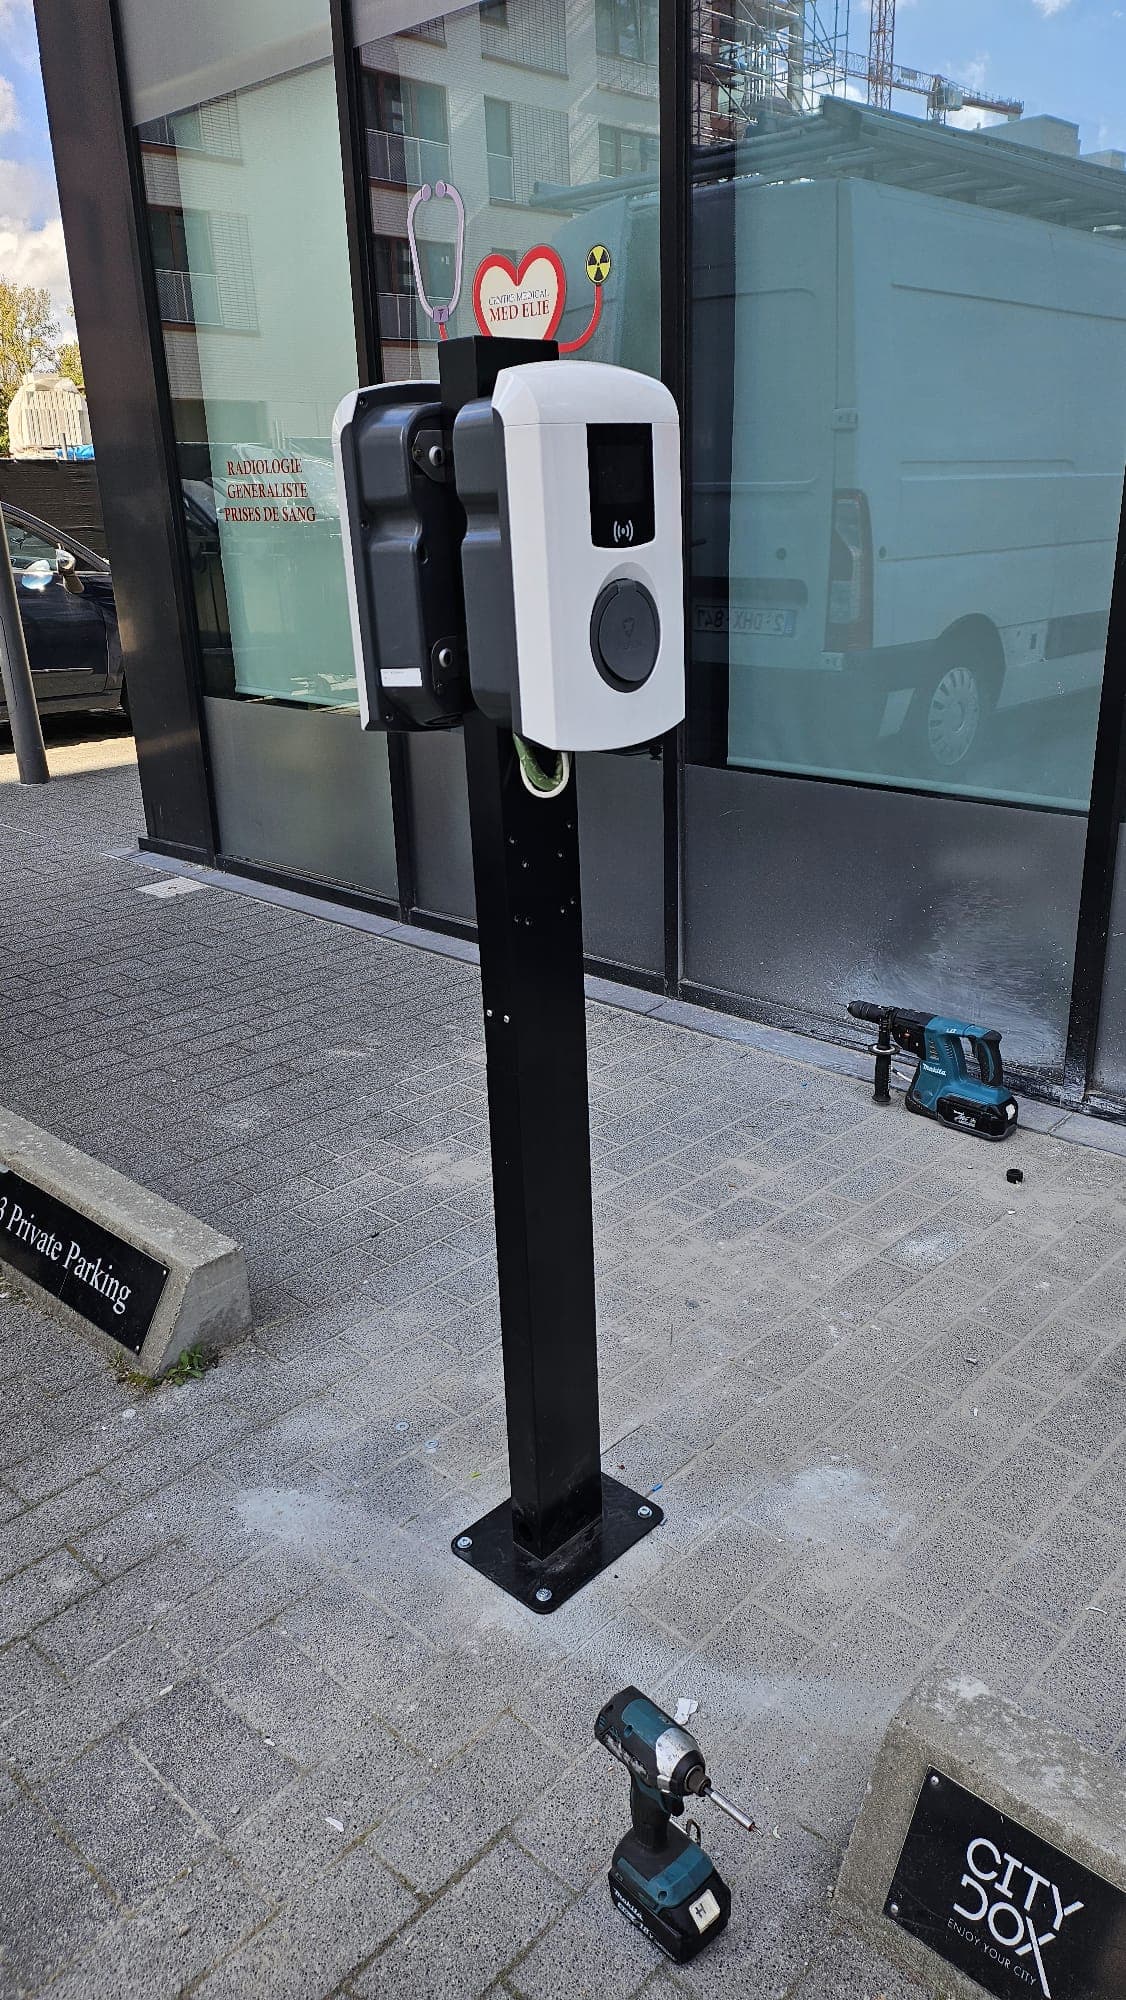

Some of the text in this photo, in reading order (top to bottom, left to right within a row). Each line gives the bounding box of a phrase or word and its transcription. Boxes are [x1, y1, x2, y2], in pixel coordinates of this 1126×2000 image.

[516, 288, 550, 302] MEDICAL
[489, 299, 550, 322] MED ELIE
[226, 458, 303, 476] RADIOLOGIE
[227, 482, 309, 499] GENERALISTE
[224, 506, 317, 522] PRISES DE SANG
[6, 1203, 63, 1261] Private
[62, 1240, 132, 1315] Parking
[966, 1837, 1085, 1931] CITY
[948, 1918, 1038, 1986] ENJOY YOUR CITY
